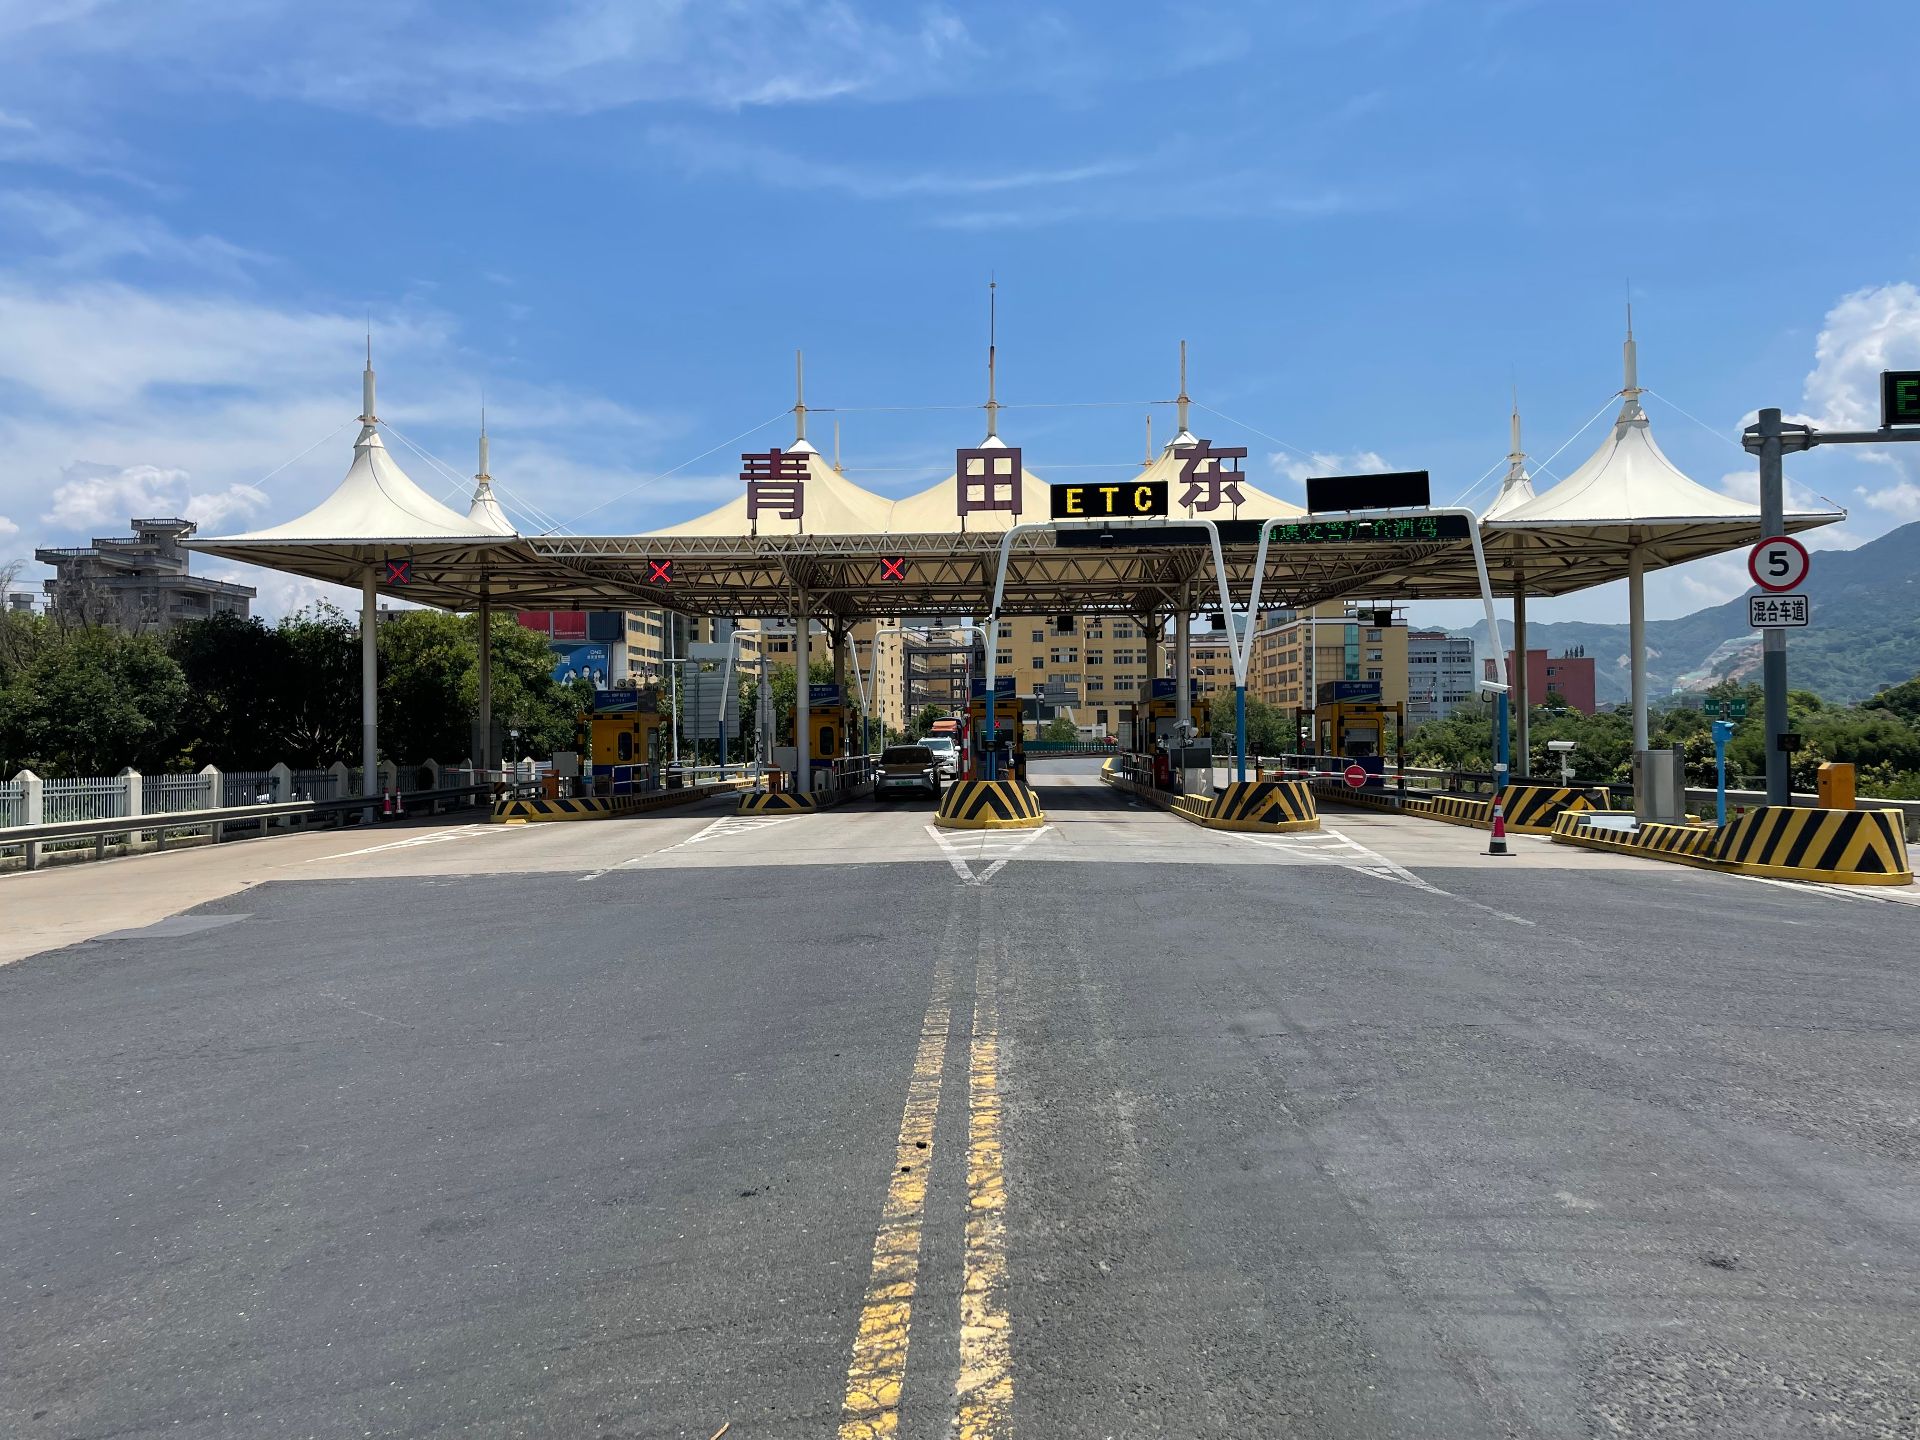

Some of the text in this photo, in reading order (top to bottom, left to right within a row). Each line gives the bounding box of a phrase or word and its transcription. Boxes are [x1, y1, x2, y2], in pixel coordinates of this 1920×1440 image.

[1066, 486, 1152, 513] ETC
[1769, 551, 1789, 576] 5
[1754, 600, 1804, 622] 混合车道
